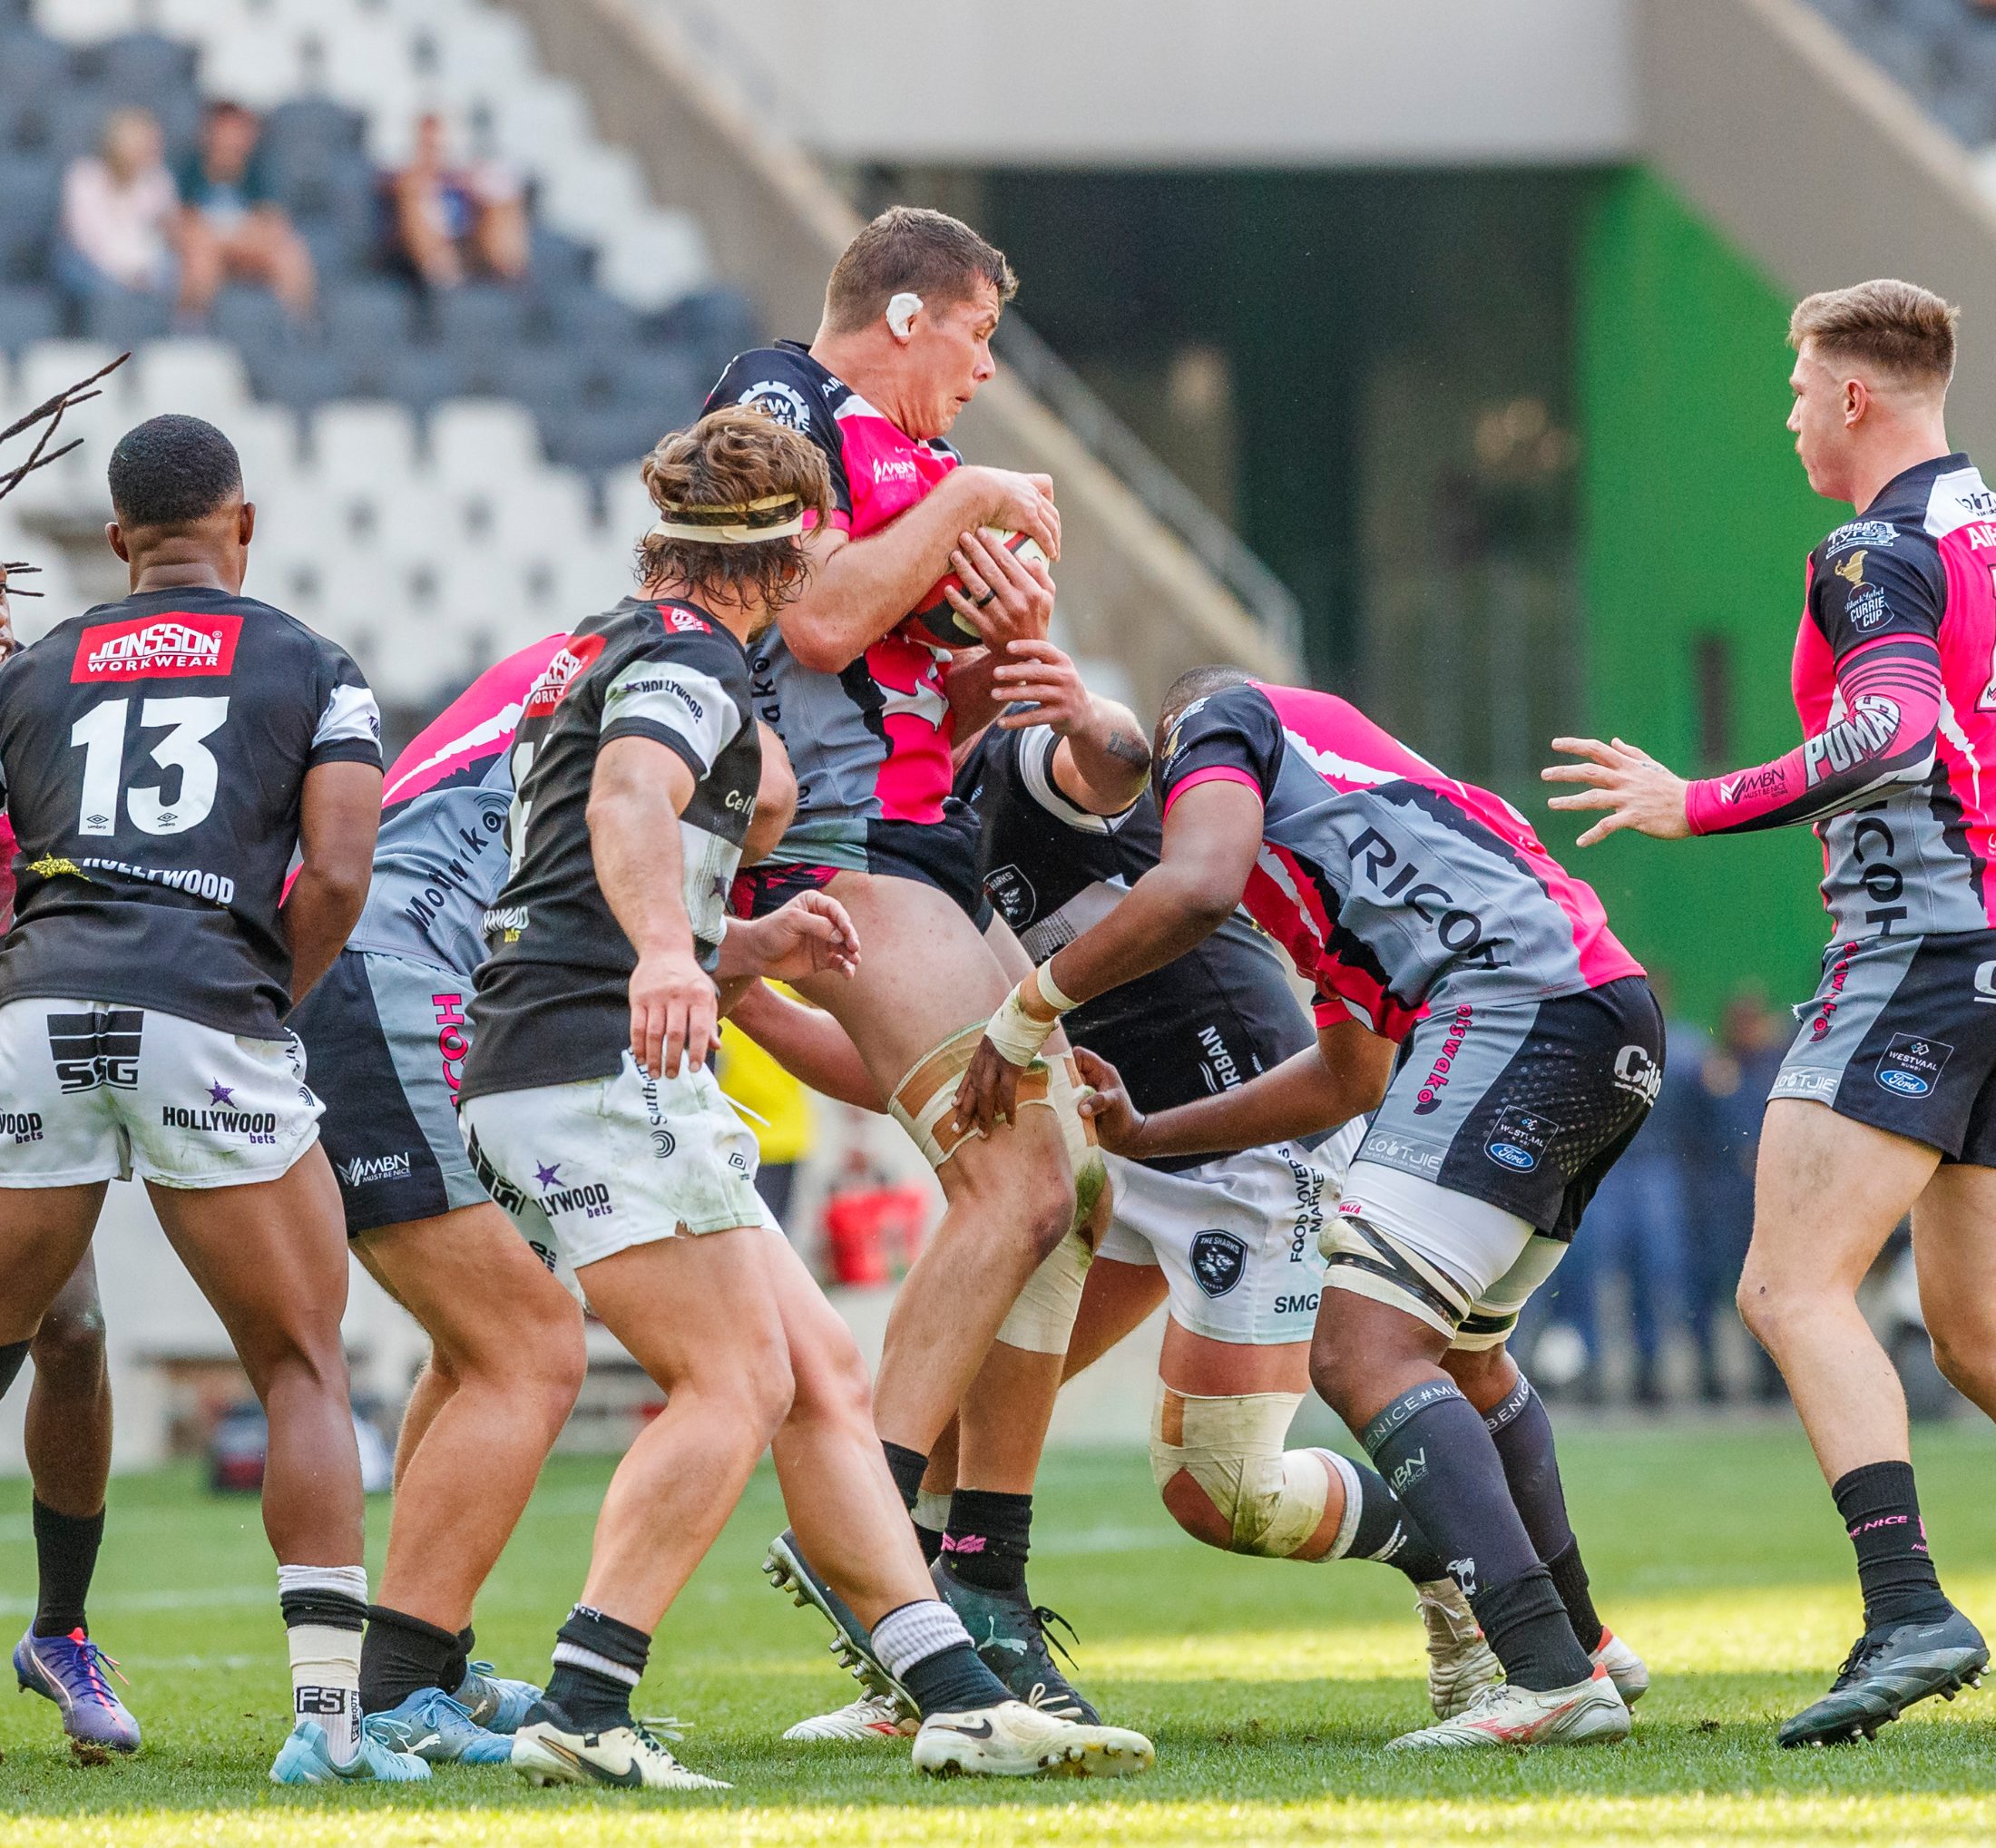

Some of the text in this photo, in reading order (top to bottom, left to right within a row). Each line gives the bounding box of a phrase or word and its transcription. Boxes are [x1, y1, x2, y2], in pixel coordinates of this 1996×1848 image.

[1850, 596, 1884, 622] CURRIE
[1863, 609, 1883, 628] CUP
[89, 623, 221, 660] JONSSON
[88, 656, 218, 672] WORKWEAR
[1805, 695, 1900, 789] PUMAS
[71, 696, 230, 836] 13
[1745, 764, 1785, 792] MBN
[1347, 826, 1512, 970] RICOH
[1889, 1051, 1937, 1071] WESTVAAL
[1889, 1072, 1919, 1090] Ford
[162, 1106, 276, 1133] HOLLYWOOD
[15, 1130, 44, 1145] bets
[249, 1133, 276, 1144] bets
[364, 1151, 410, 1177] MBN
[1498, 1146, 1527, 1165] Ford
[363, 1173, 382, 1183] MUST
[383, 1170, 392, 1178] BE
[393, 1168, 411, 1177] NICE
[587, 1205, 612, 1218] bets
[1214, 1237, 1240, 1254] SHARKS
[1289, 1214, 1309, 1263] FOOD
[1274, 1293, 1319, 1314] SMG
[1864, 1515, 1908, 1531] NICE
[298, 1688, 341, 1714] FS
